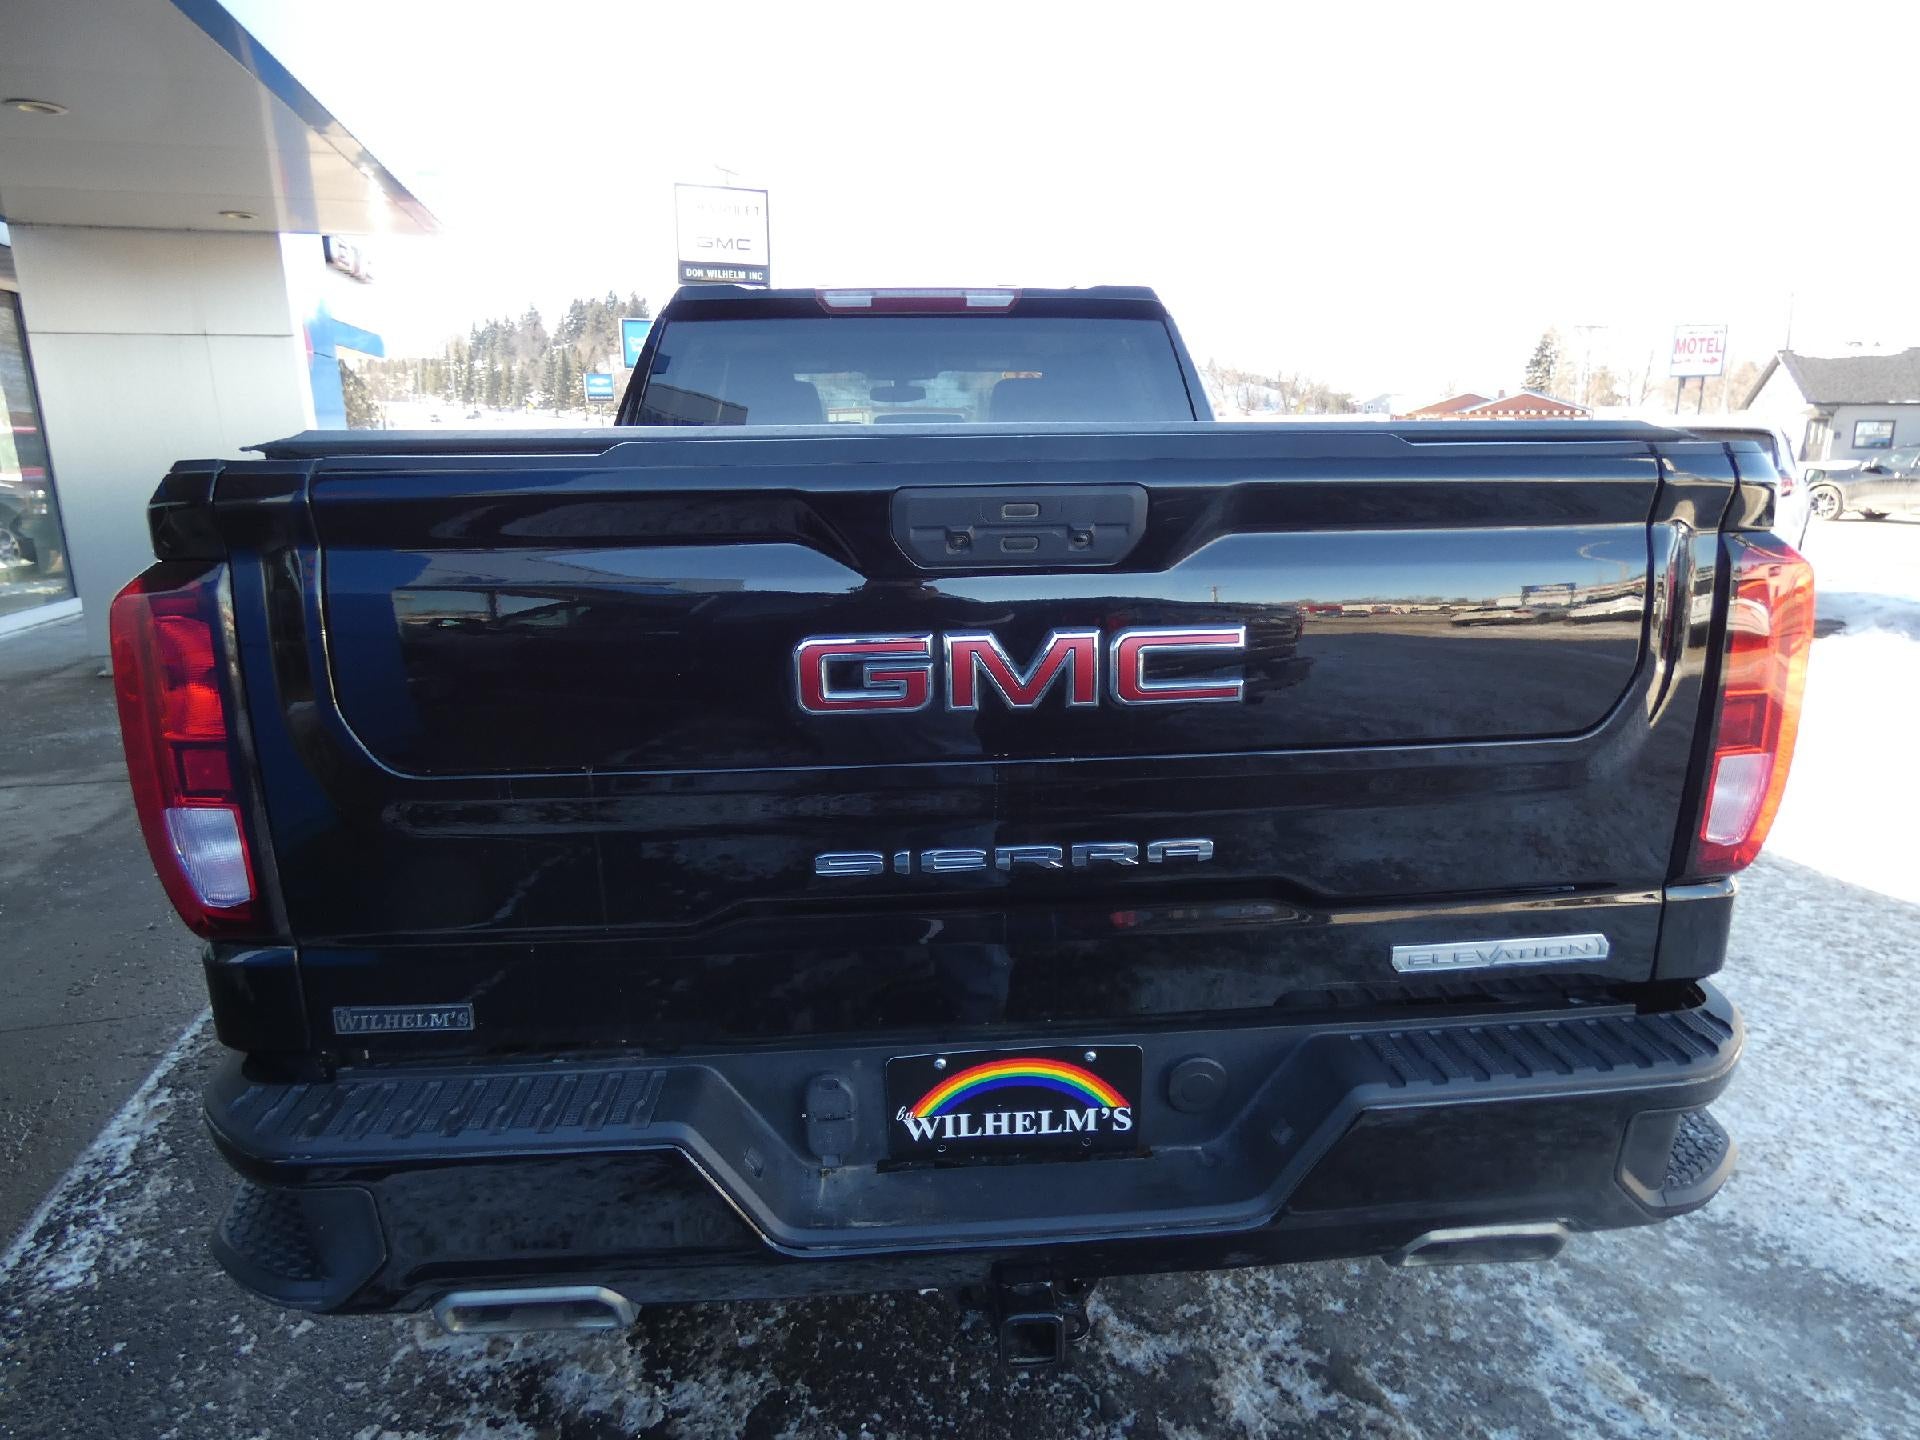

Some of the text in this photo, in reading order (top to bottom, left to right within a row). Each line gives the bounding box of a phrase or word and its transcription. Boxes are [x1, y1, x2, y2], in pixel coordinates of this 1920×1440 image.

[697, 237, 751, 250] GMC
[685, 268, 764, 281] DON WILHELM INC
[1674, 337, 1723, 354] MOTEL
[793, 626, 1246, 713] GMC
[814, 837, 1215, 877] SIERRA
[1407, 942, 1593, 967] ELEVATION
[337, 1011, 469, 1030] WILHELM'S
[896, 1105, 1133, 1142] by WILHELM'S
